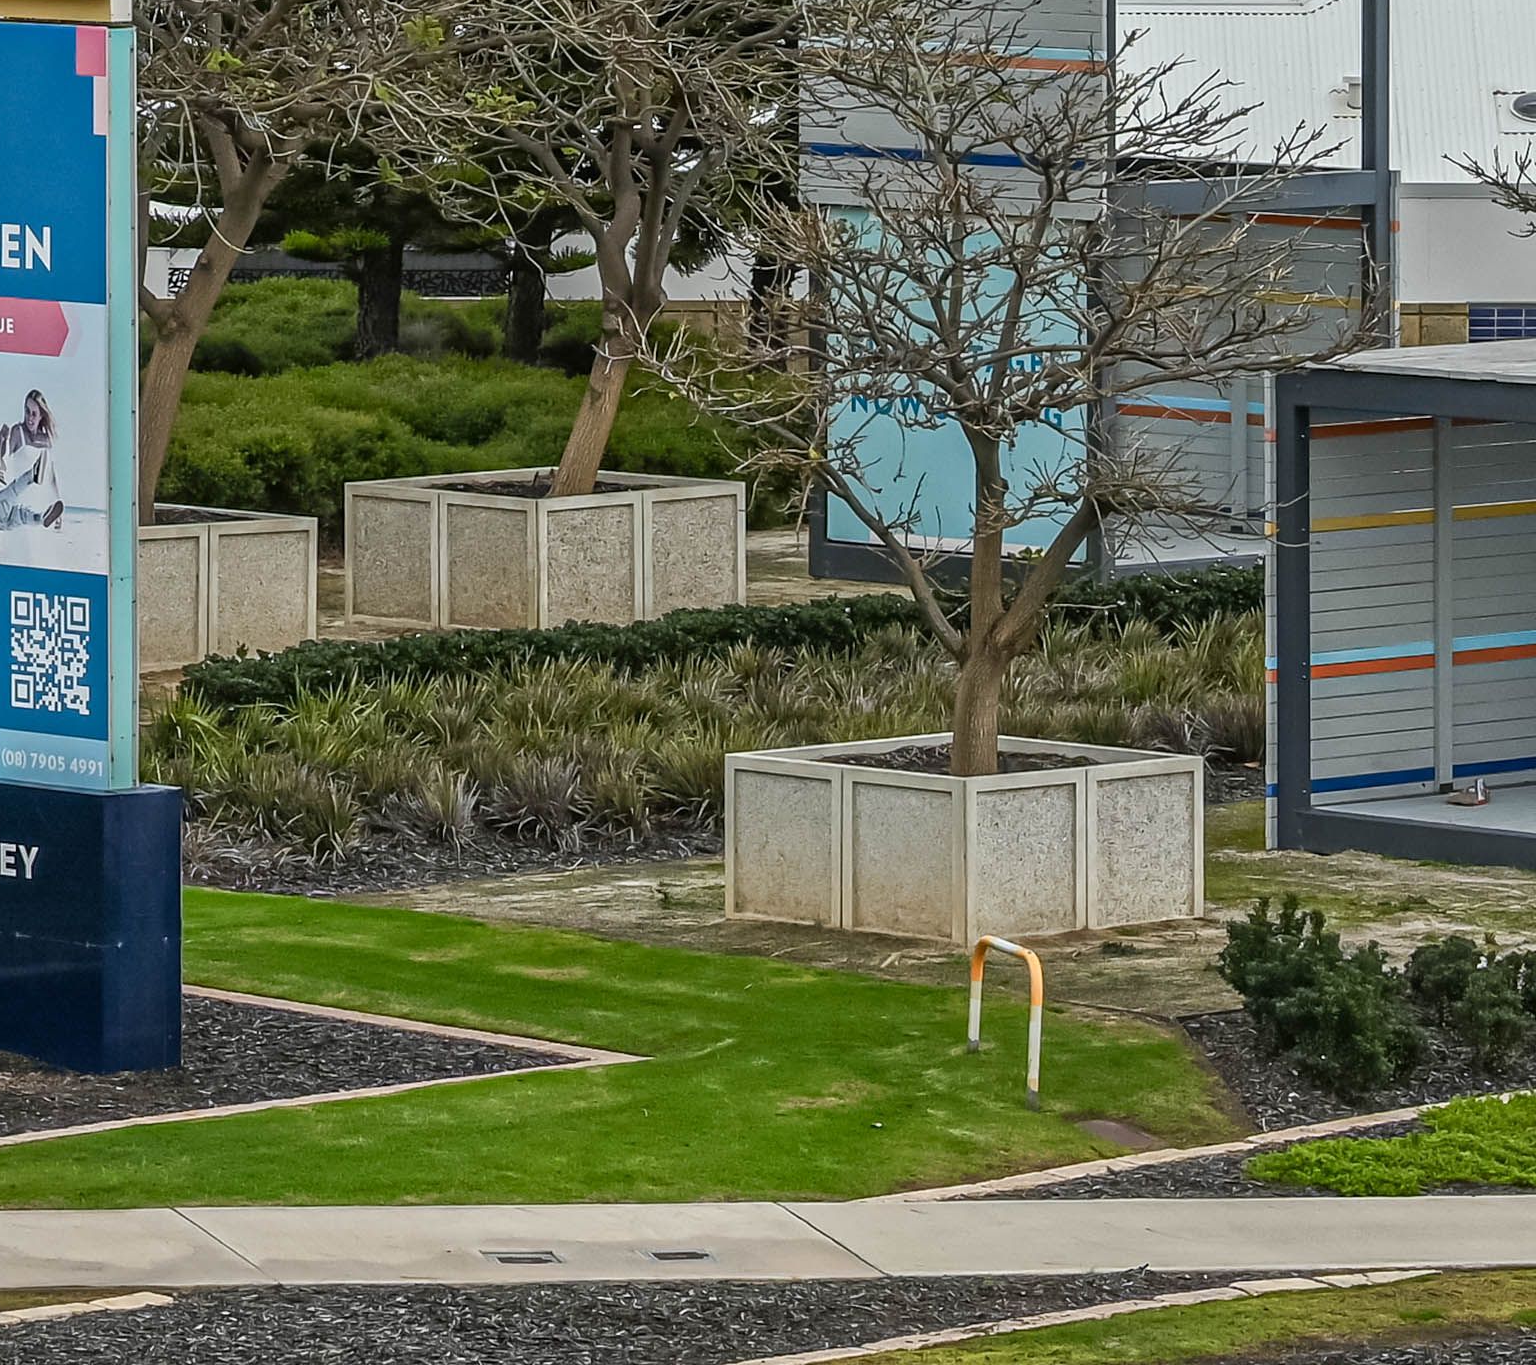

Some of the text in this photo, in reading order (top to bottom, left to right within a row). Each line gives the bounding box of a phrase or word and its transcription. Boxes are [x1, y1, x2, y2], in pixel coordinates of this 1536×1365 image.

[1, 747, 103, 777] (08) 7905 4991
